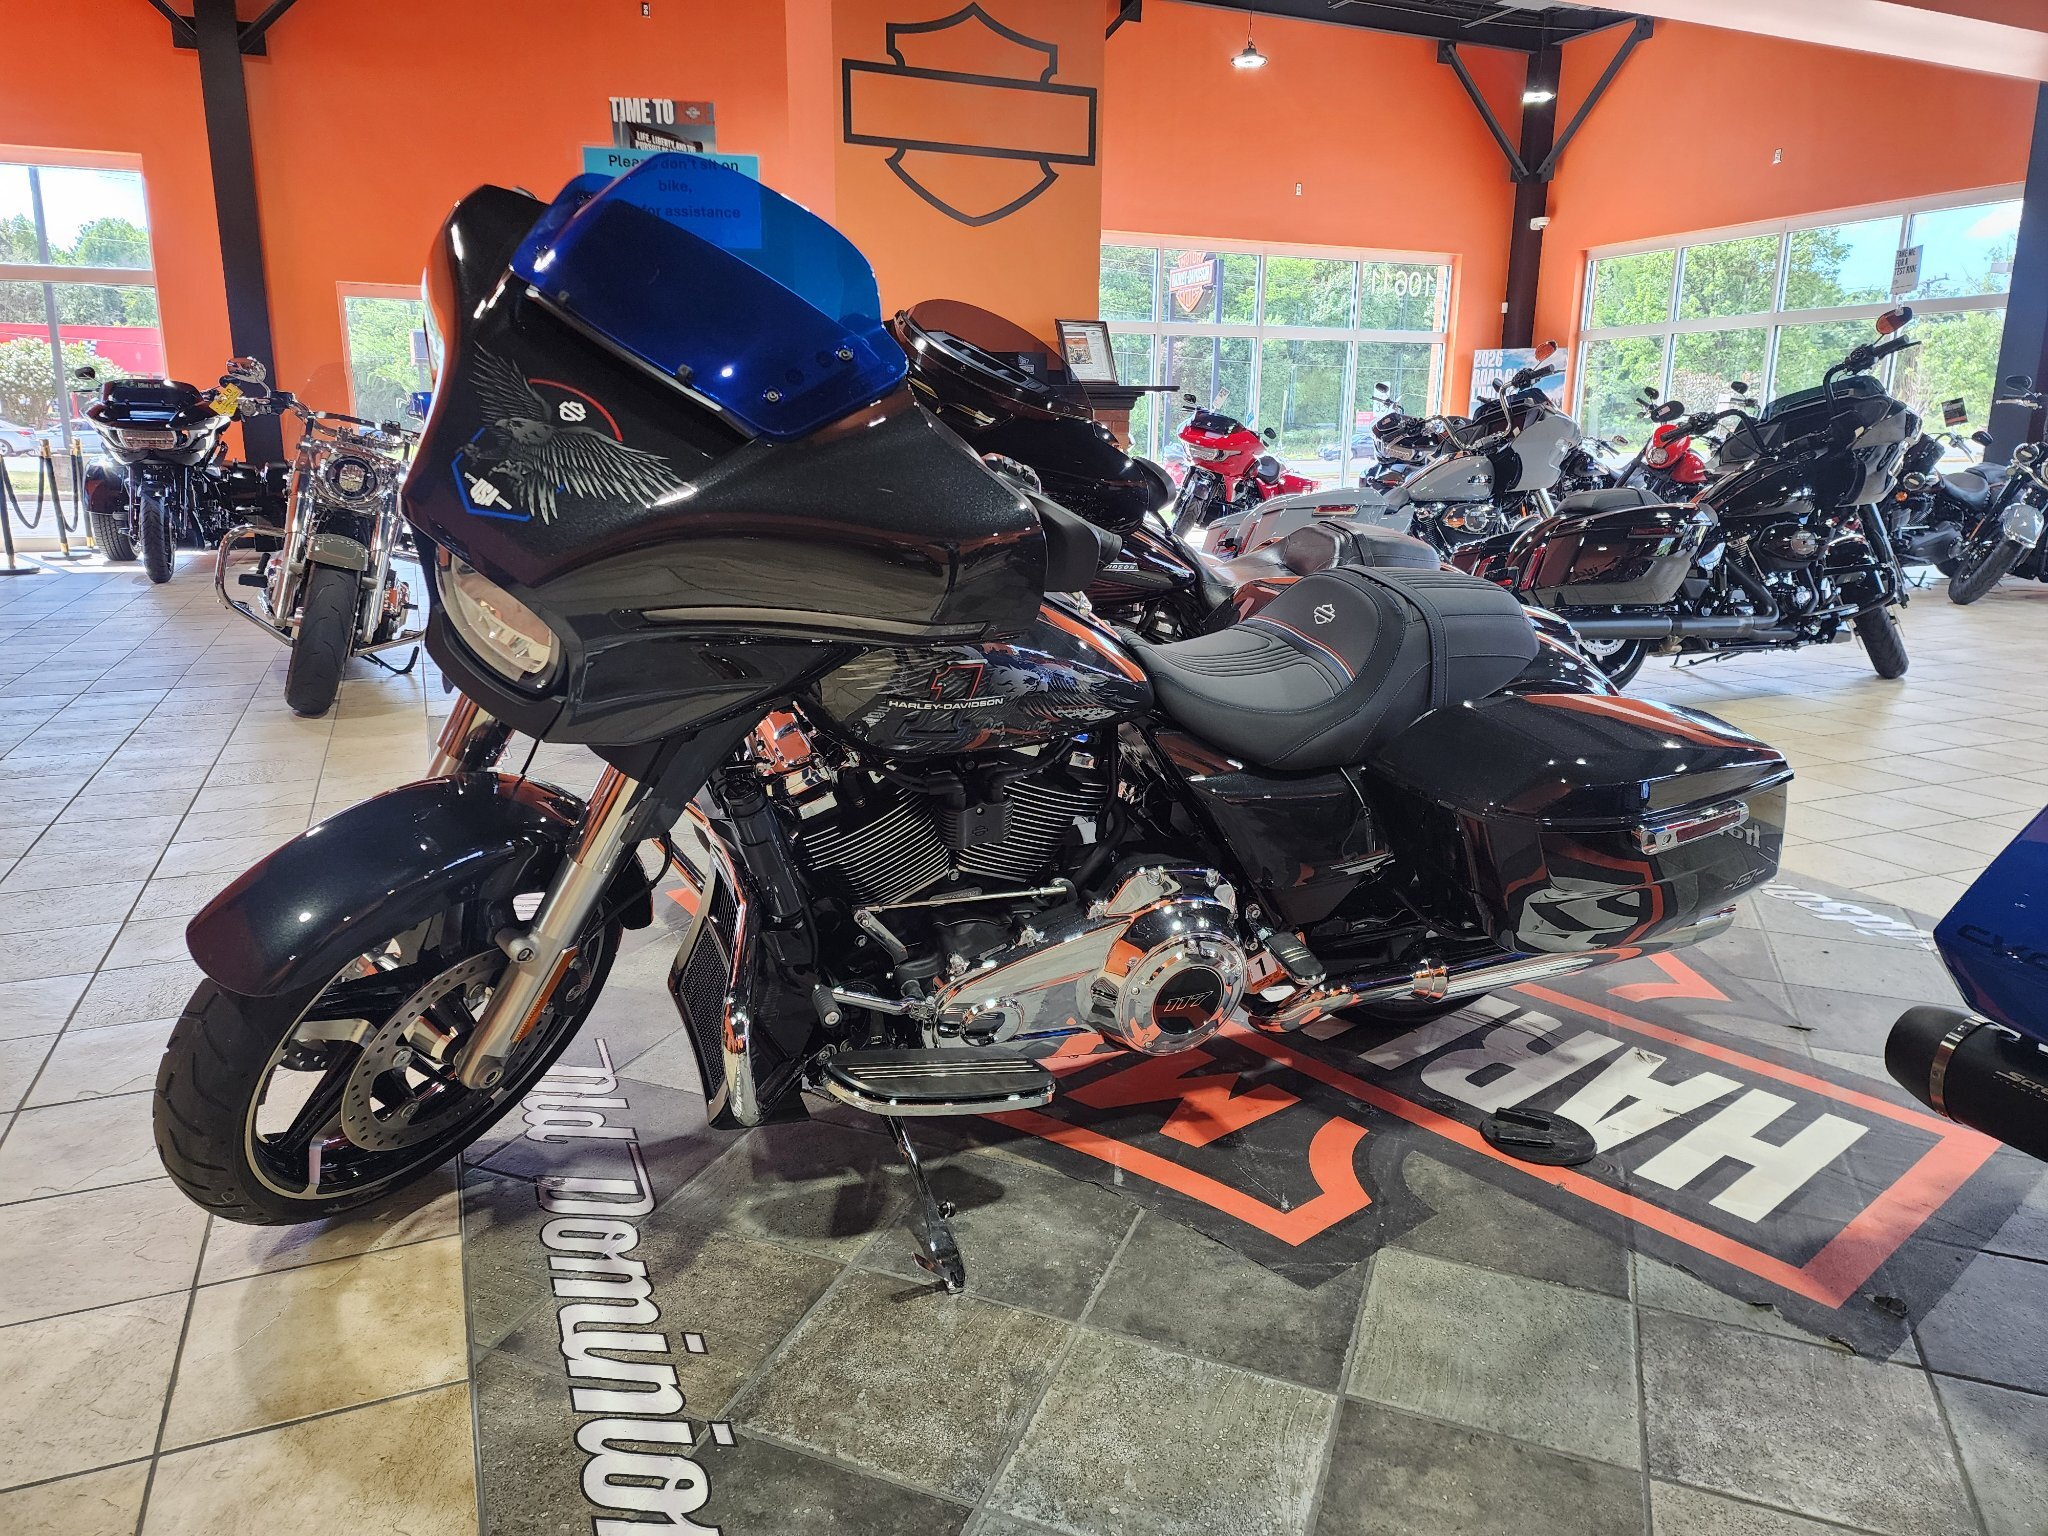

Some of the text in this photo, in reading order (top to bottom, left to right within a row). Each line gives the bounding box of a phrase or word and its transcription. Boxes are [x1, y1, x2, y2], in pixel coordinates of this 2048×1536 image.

[609, 97, 651, 124] TIME
[652, 98, 675, 125] TO
[635, 130, 652, 143] LIFE,
[608, 153, 658, 169] Pleae
[660, 157, 697, 170] don't
[719, 160, 739, 172] on
[659, 180, 693, 194] bike,
[664, 206, 741, 219] assistance
[1895, 266, 1906, 275] TEST
[1474, 350, 1504, 367] 2026
[470, 477, 500, 506] USA
[888, 698, 1004, 710] HARLEY-DAVIDSON
[1255, 957, 1267, 977] 1
[1164, 990, 1215, 1012] 117
